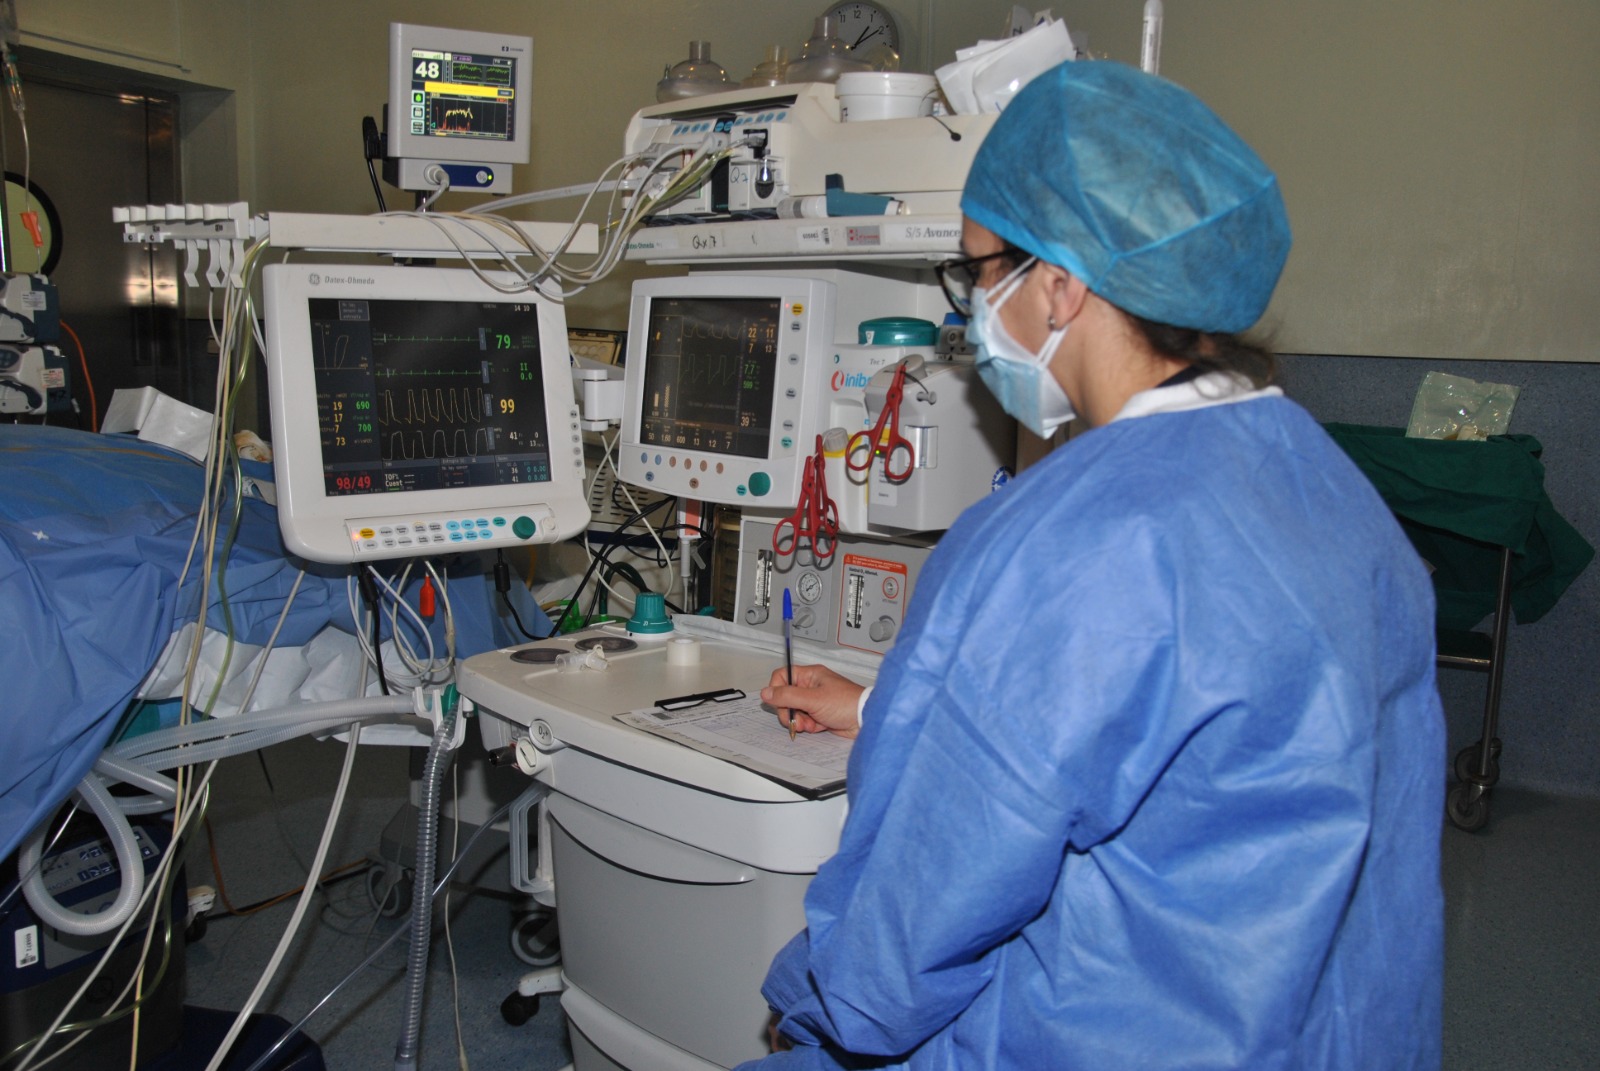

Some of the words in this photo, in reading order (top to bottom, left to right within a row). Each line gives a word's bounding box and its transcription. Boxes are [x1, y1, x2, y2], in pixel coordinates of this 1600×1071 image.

[840, 14, 846, 23] 11
[854, 10, 861, 19] 12
[870, 14, 874, 22] 1
[878, 26, 884, 35] 2
[414, 60, 440, 79] 48
[906, 227, 921, 238] S/5
[923, 226, 961, 238] Avance
[324, 276, 375, 285] Datex-Ohmeda
[748, 327, 757, 338] 22
[766, 328, 774, 338] 11
[496, 334, 511, 349] 79
[749, 343, 754, 354] 7
[765, 345, 772, 353] 13
[520, 372, 533, 380] 0.0
[333, 401, 343, 411] 19
[356, 401, 370, 410] 690
[500, 399, 515, 413] 99
[334, 413, 343, 423] 17
[740, 416, 750, 427] 39
[335, 424, 340, 434] 7
[357, 423, 372, 432] 700
[509, 431, 518, 440] 41
[336, 437, 346, 446] 73
[694, 438, 700, 446] 13
[726, 441, 731, 449] 7
[336, 475, 372, 490] 98/49
